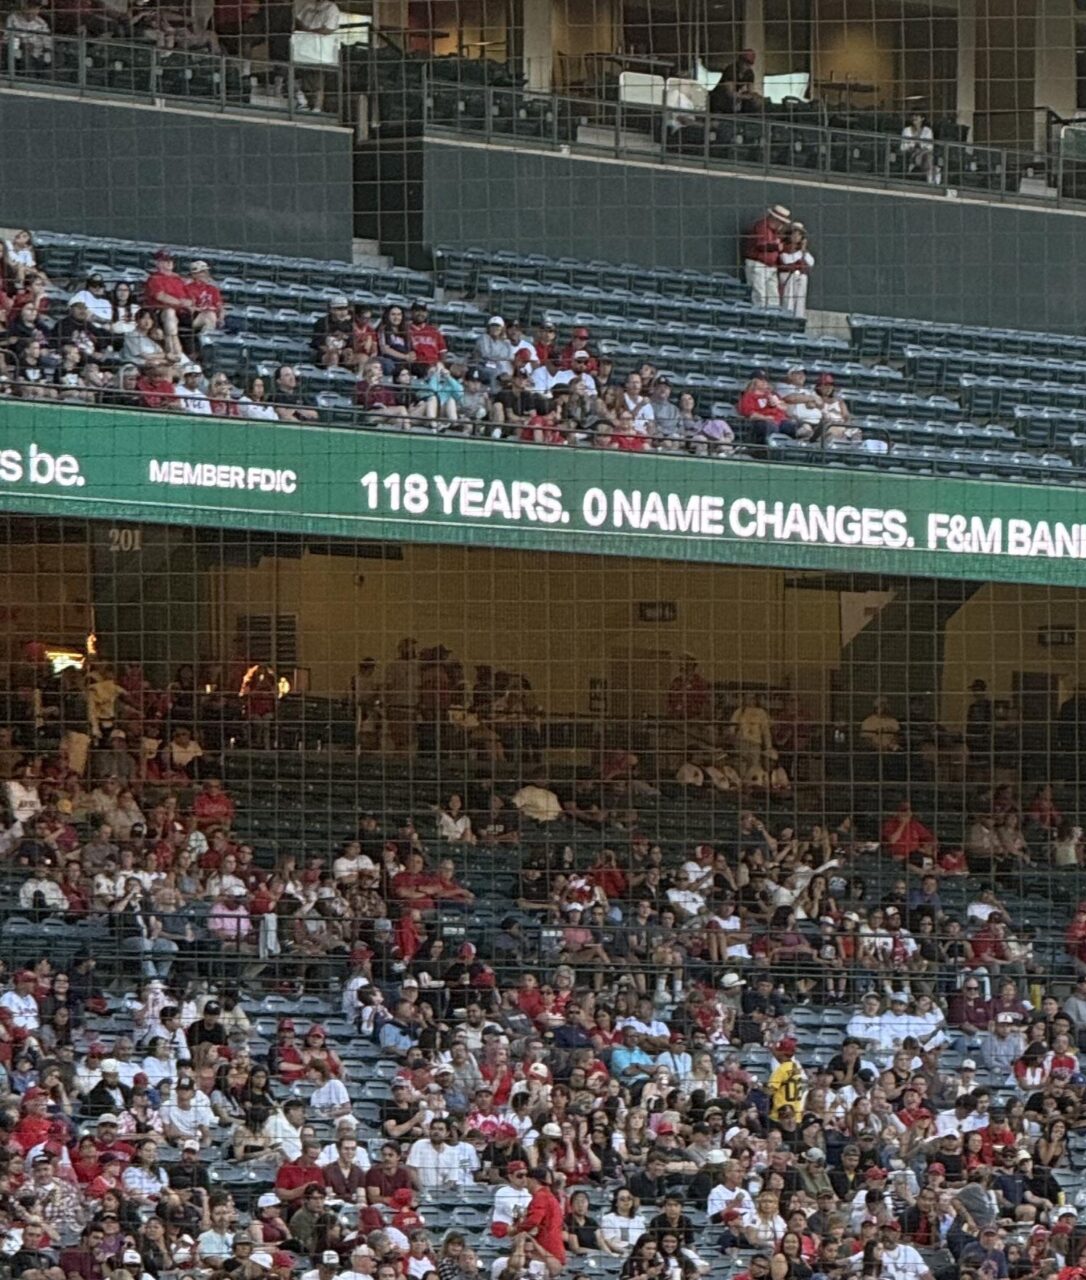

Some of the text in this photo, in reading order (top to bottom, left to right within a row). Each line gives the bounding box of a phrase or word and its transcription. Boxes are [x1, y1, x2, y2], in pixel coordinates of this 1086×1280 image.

[29, 443, 86, 487] be.
[149, 459, 297, 494] MEMBER FDIC
[360, 471, 429, 514] 118
[433, 475, 570, 524] YEARS.
[583, 487, 608, 527] 0
[612, 488, 725, 535] NAME
[728, 497, 916, 549] CHANGES.
[927, 513, 1003, 555] F&M
[108, 528, 142, 552] 201
